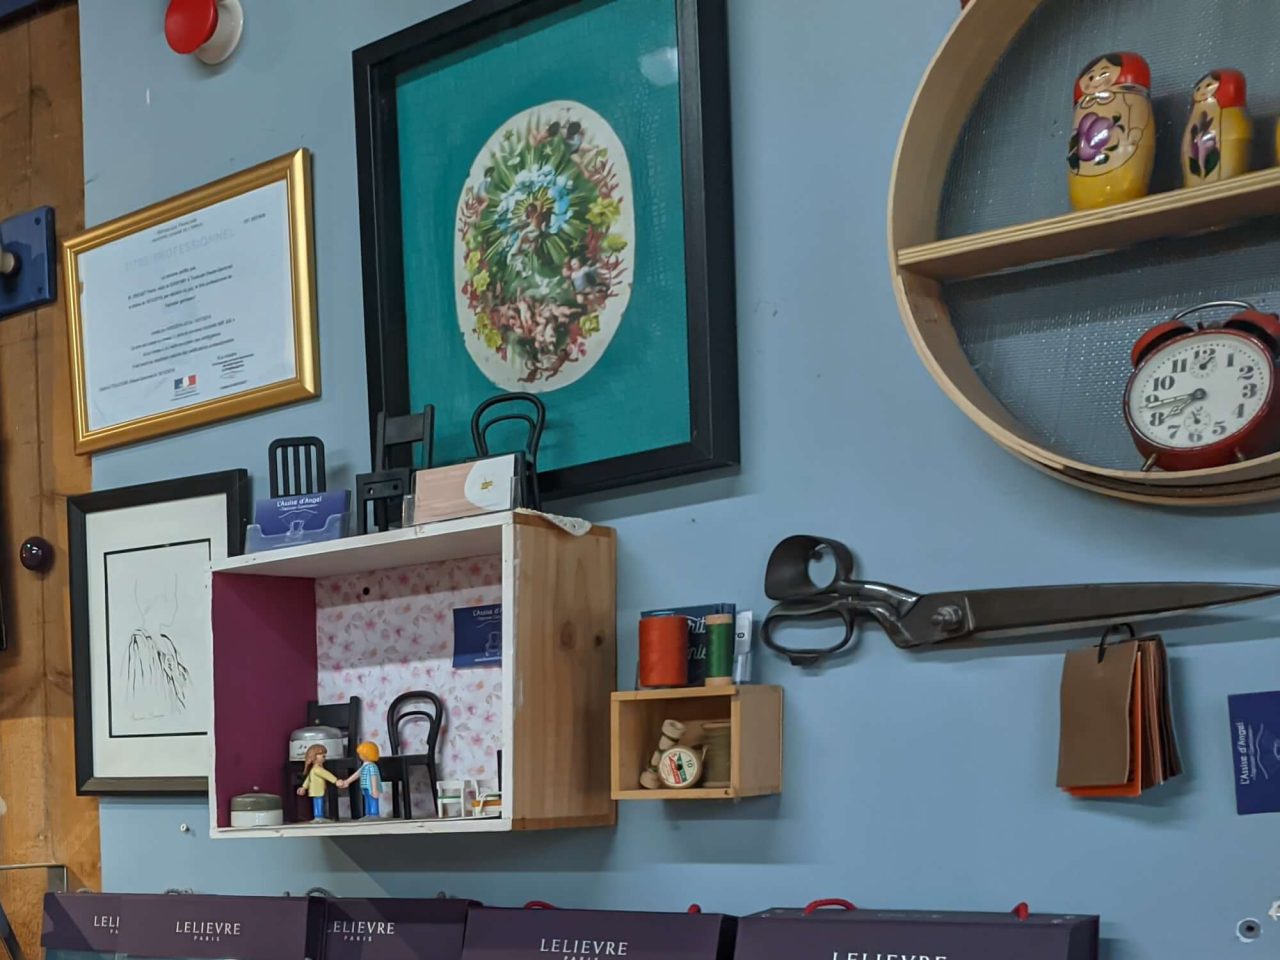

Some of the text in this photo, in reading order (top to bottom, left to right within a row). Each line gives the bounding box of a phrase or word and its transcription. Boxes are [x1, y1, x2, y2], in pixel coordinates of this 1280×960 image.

[1172, 358, 1187, 373] 11
[1227, 353, 1234, 367] 1
[1237, 365, 1254, 380] 2
[1153, 375, 1175, 391] 10
[1242, 383, 1258, 399] 3
[1233, 403, 1245, 418] 4
[1150, 411, 1165, 427] 8
[1168, 424, 1181, 439] 7
[1212, 421, 1227, 436] 5
[175, 920, 241, 935] LELIEVRE
[540, 938, 629, 956] LELIEVRE
